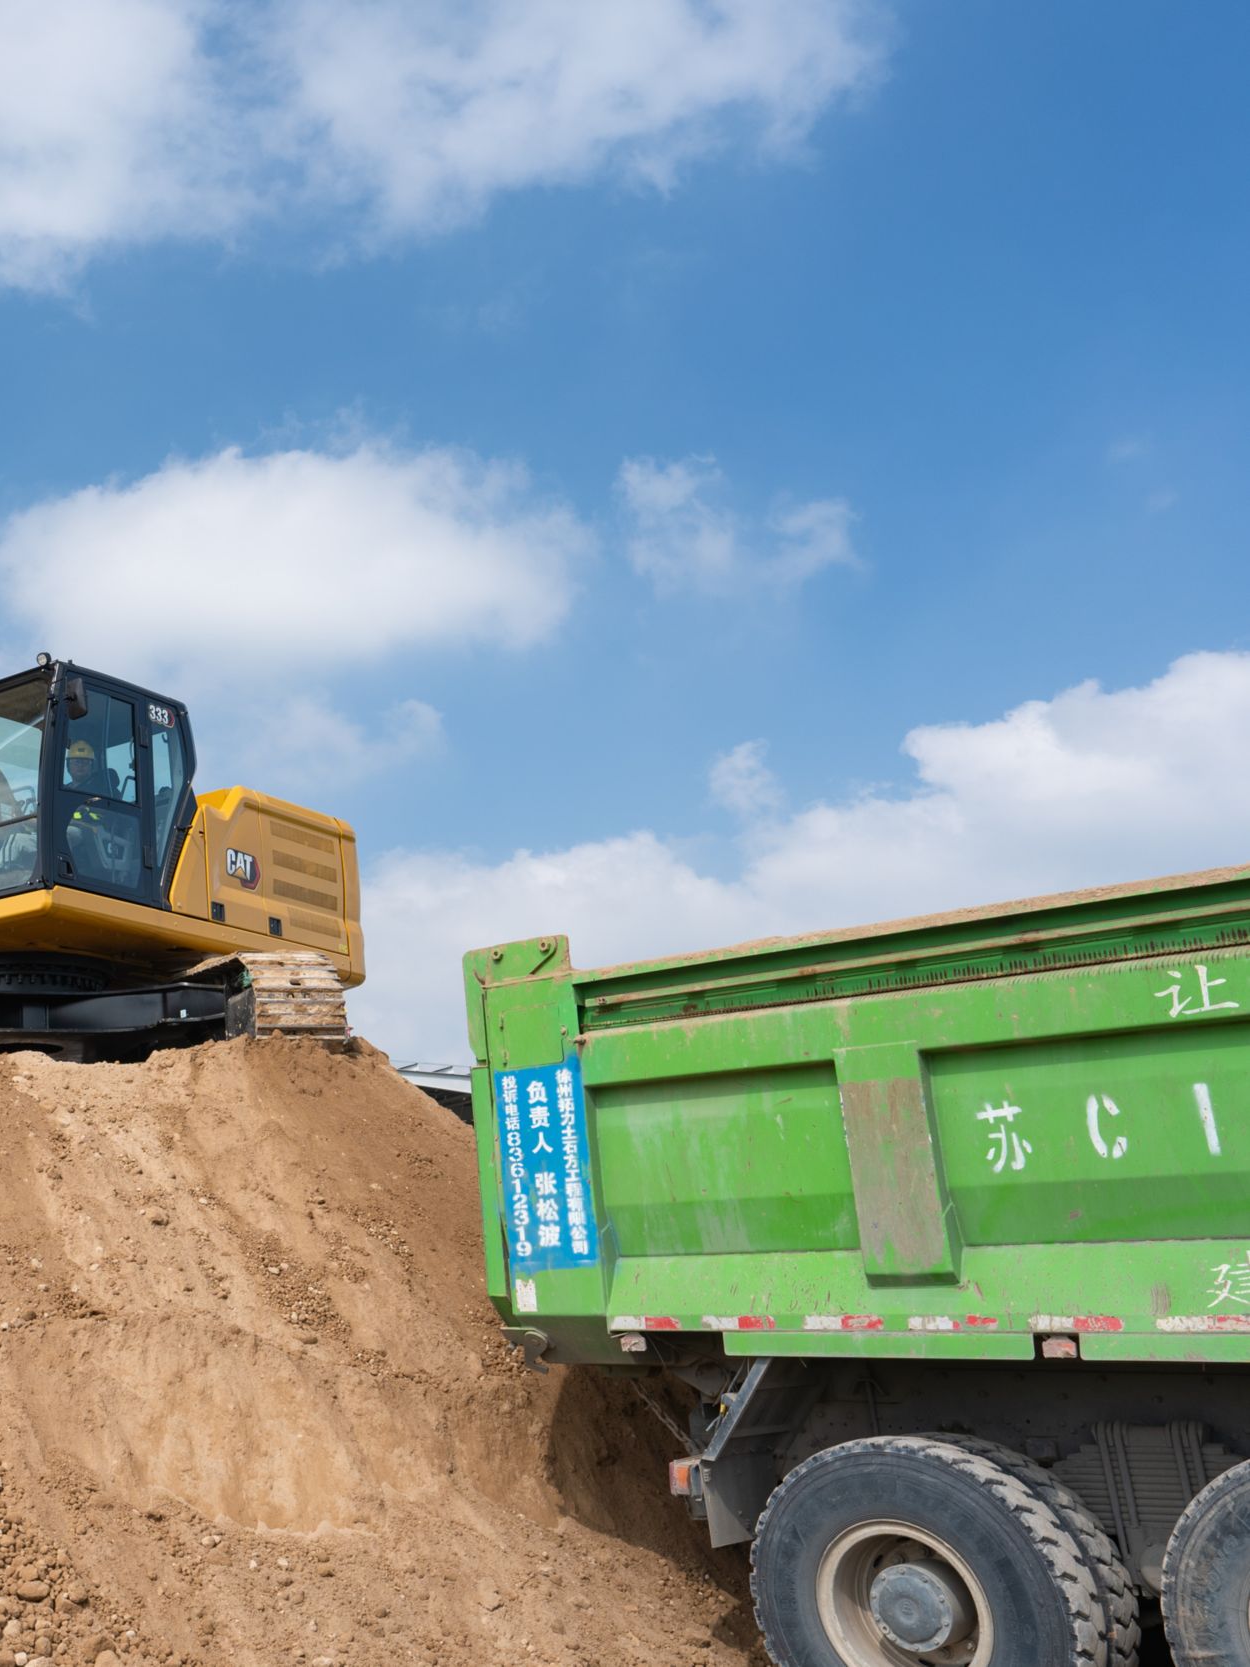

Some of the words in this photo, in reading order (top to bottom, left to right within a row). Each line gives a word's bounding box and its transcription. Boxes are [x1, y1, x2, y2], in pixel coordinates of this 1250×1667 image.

[149, 704, 168, 725] 333
[226, 848, 253, 881] CAT
[1154, 964, 1240, 1018] 让
[526, 1080, 553, 1155] 负责人
